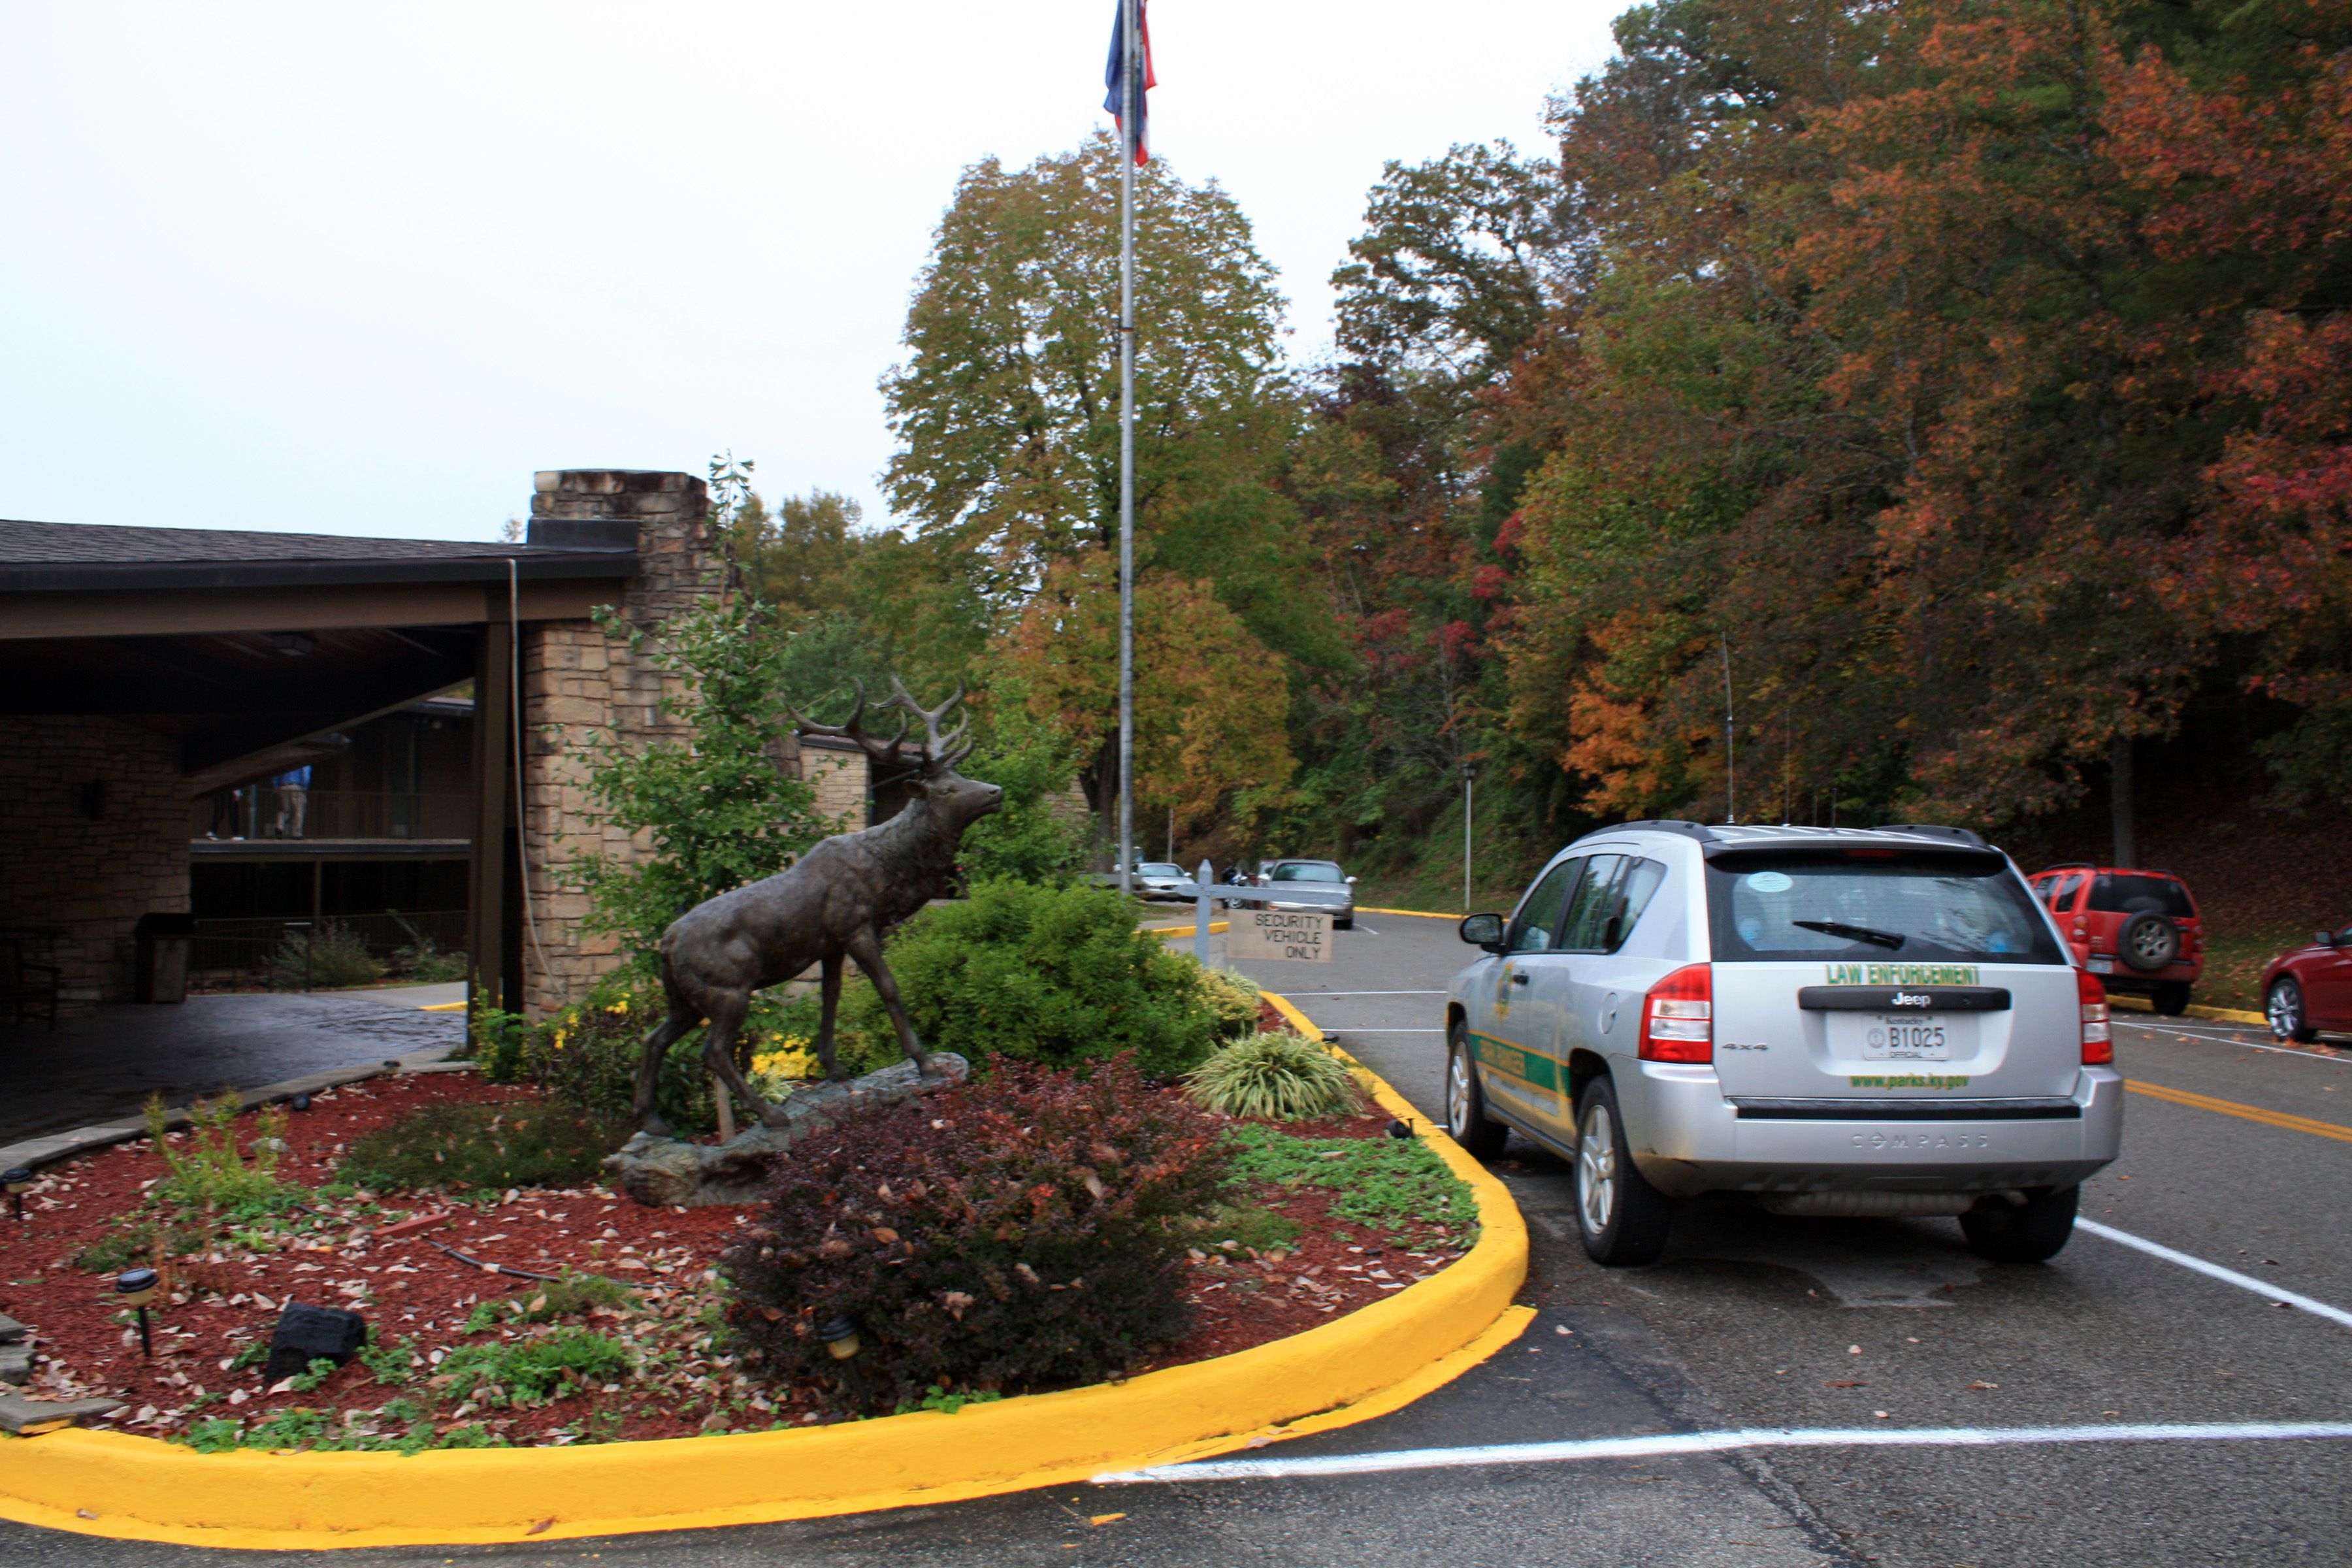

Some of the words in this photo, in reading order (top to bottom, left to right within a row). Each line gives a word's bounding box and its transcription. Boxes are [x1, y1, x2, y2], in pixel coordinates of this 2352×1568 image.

[1255, 913, 1324, 929] SECURITY
[1264, 929, 1322, 945] VEHICLE
[1286, 945, 1321, 960] ONLY
[1826, 964, 1861, 985] LAW
[1866, 964, 1980, 985] ENFORCEMENT
[1892, 992, 1931, 1007] Jeep
[1885, 1017, 1924, 1025] Kentucky
[1889, 1027, 1944, 1047] B1025
[1850, 1073, 1970, 1090] www.parks.ky.gov
[1851, 1132, 1988, 1149] COMPASS
